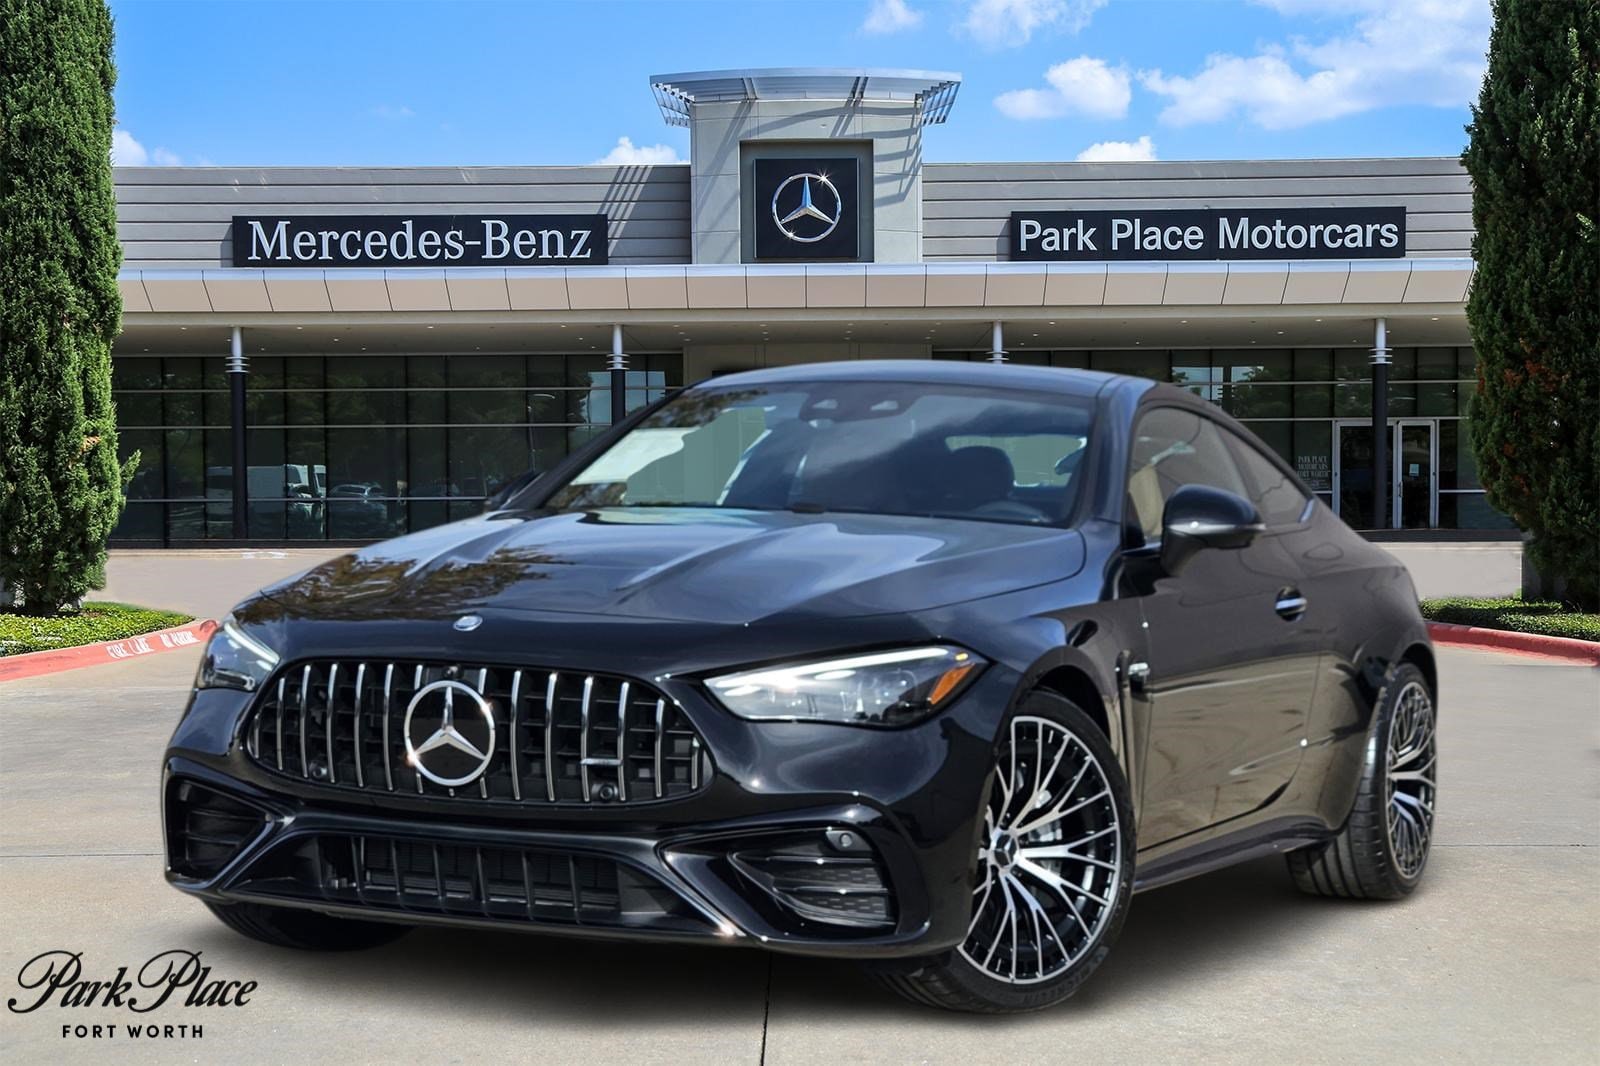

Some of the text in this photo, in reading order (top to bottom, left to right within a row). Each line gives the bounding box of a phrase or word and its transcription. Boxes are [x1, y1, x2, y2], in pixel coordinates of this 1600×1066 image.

[247, 219, 592, 260] Mercedes-Benz
[1019, 217, 1400, 252] Park Place Motorcars
